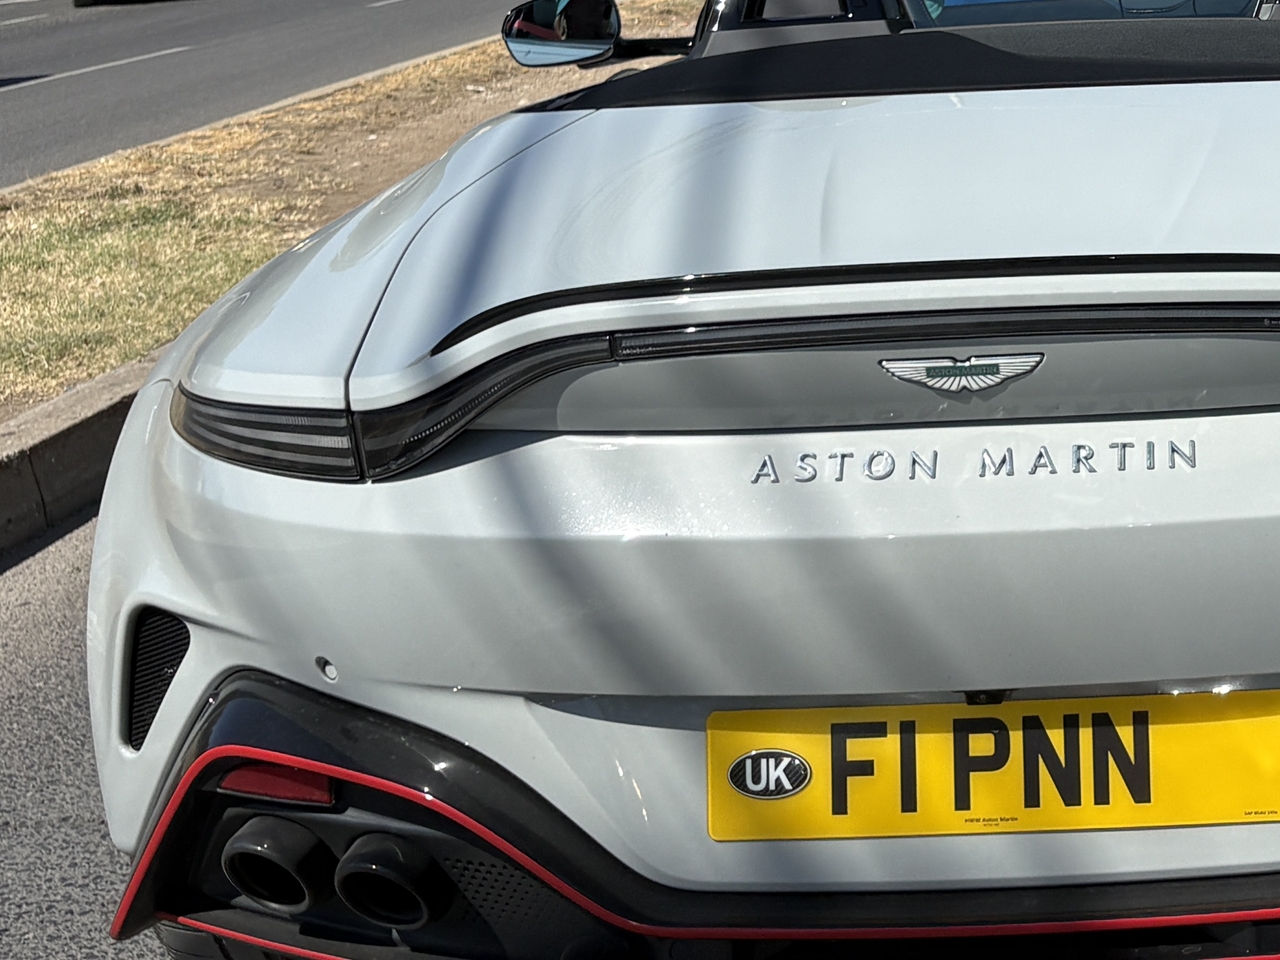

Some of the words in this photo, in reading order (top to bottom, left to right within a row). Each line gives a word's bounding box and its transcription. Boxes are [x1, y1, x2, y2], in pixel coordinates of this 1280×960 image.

[929, 367, 959, 377] ASTON
[962, 365, 998, 375] MARTIN
[751, 449, 938, 484] ASTON
[979, 439, 1197, 478] MARTIN
[745, 757, 794, 792] UK
[952, 710, 1152, 813] PNN
